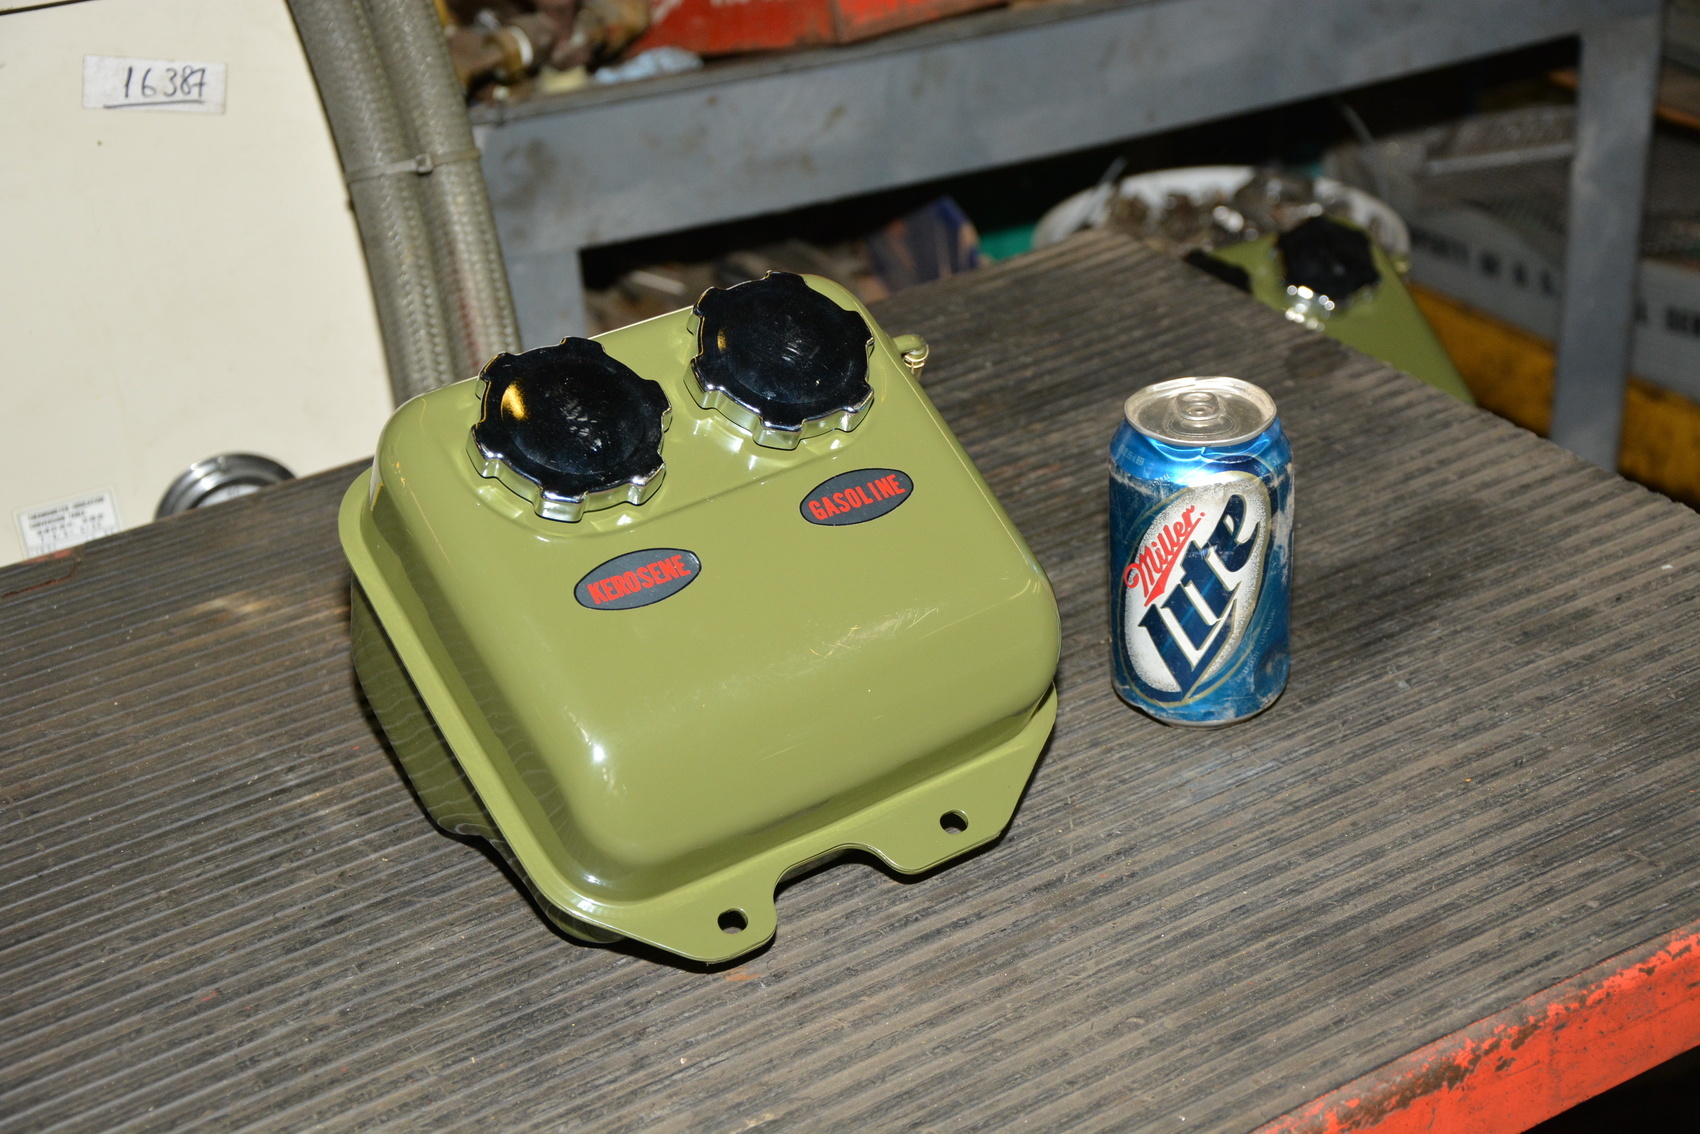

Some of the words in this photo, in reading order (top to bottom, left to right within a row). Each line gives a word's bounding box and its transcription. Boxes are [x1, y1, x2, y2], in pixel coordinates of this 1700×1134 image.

[125, 65, 206, 98] 16387
[808, 474, 906, 520] GASOLINE
[587, 554, 691, 605] KEROSENE
[1138, 494, 1260, 702] Lite
